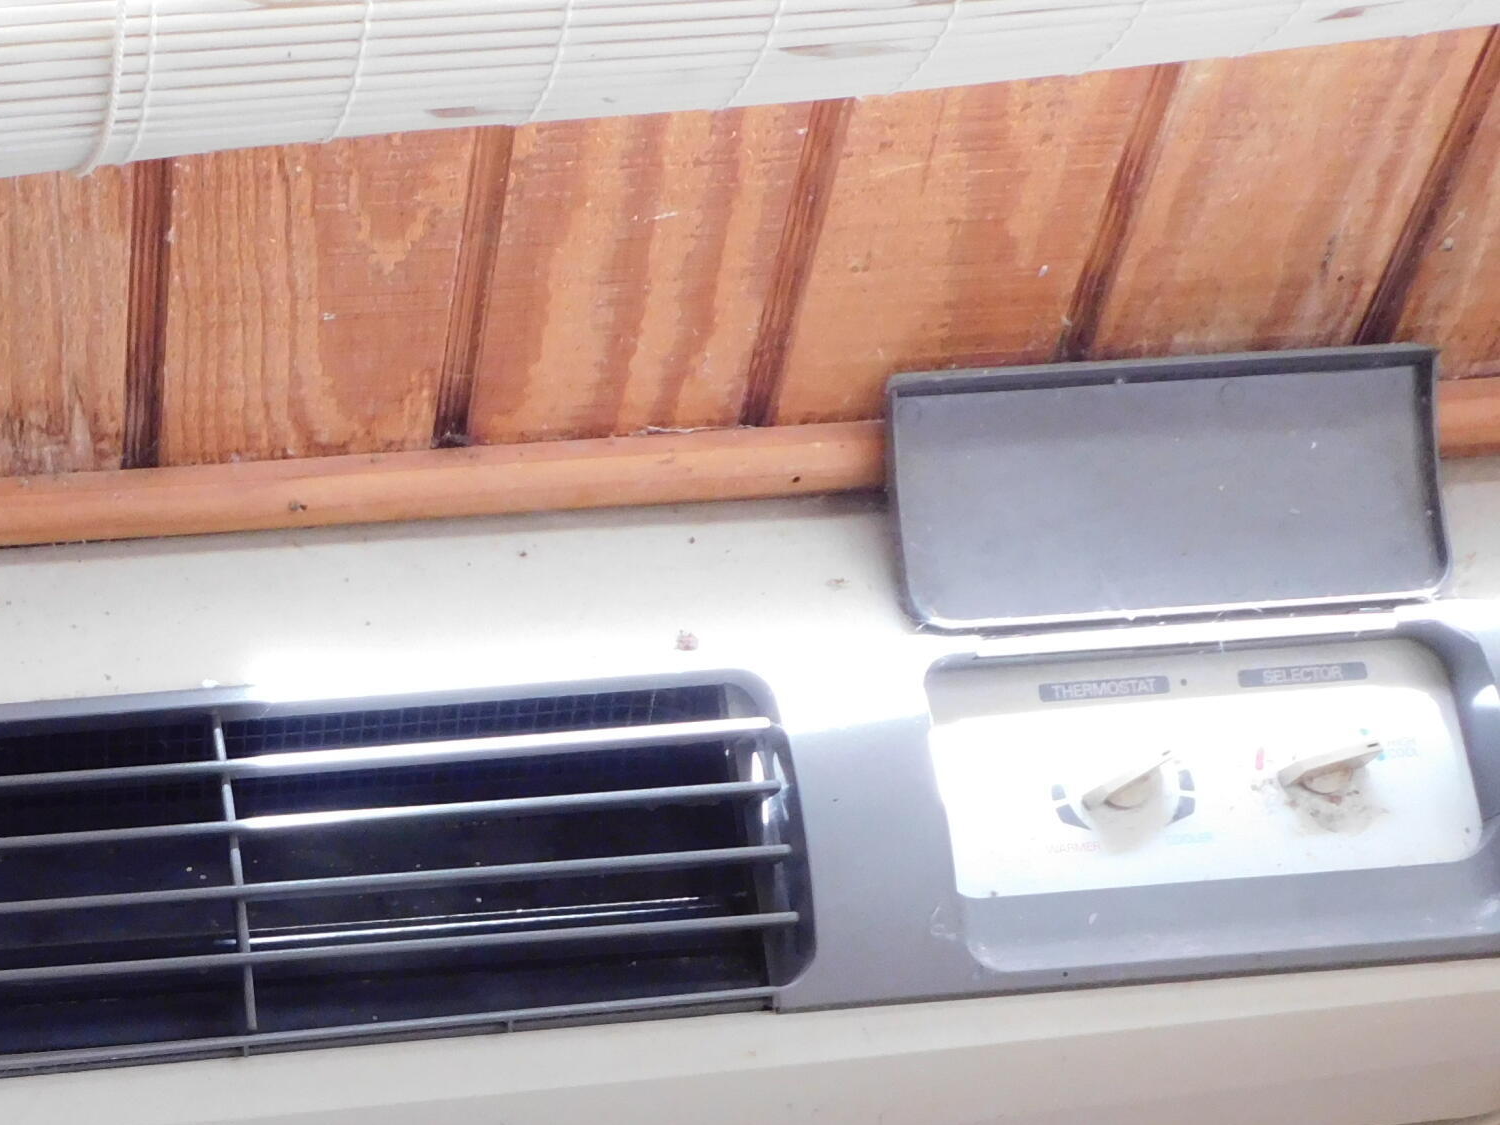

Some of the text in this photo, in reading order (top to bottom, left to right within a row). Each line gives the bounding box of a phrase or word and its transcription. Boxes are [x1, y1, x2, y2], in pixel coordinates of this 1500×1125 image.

[1263, 665, 1343, 684] SELECTOR
[1052, 678, 1155, 698] THERMOSTAT
[1048, 841, 1101, 854] WARMER
